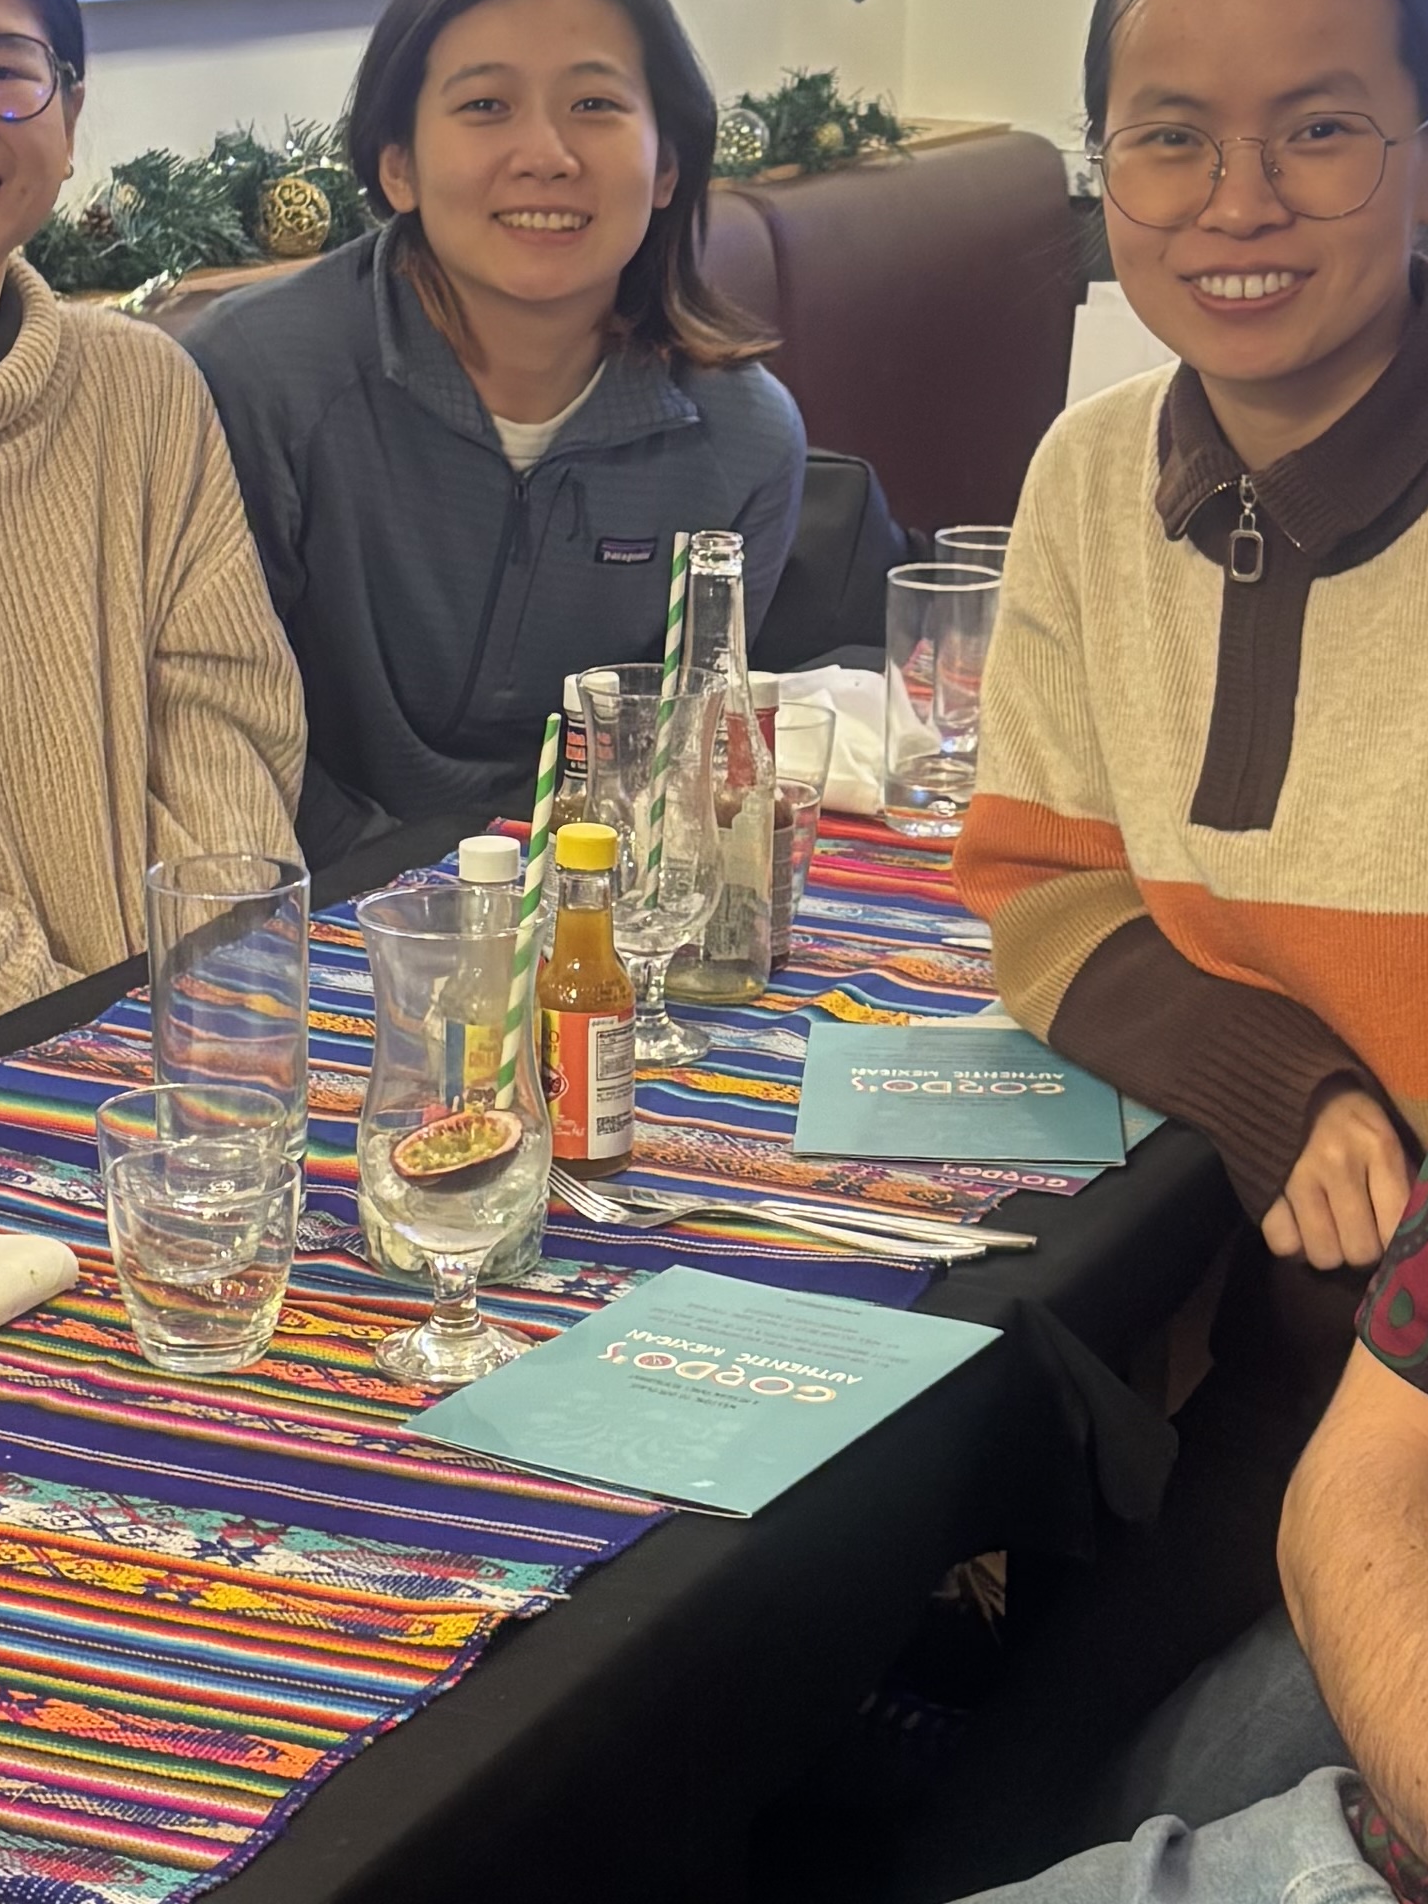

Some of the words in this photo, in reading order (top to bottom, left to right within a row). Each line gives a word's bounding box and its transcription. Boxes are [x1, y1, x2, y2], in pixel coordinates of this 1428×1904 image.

[851, 1067, 939, 1078] MEXICAN
[952, 1070, 1065, 1080] AUTHENTIC
[851, 1077, 1065, 1095] GORDO'S
[942, 1164, 1069, 1188] GORDO'S
[625, 1329, 726, 1358] MEXICAN
[597, 1342, 837, 1403] GORDO'S
[735, 1352, 863, 1385] AUTHENTIC
